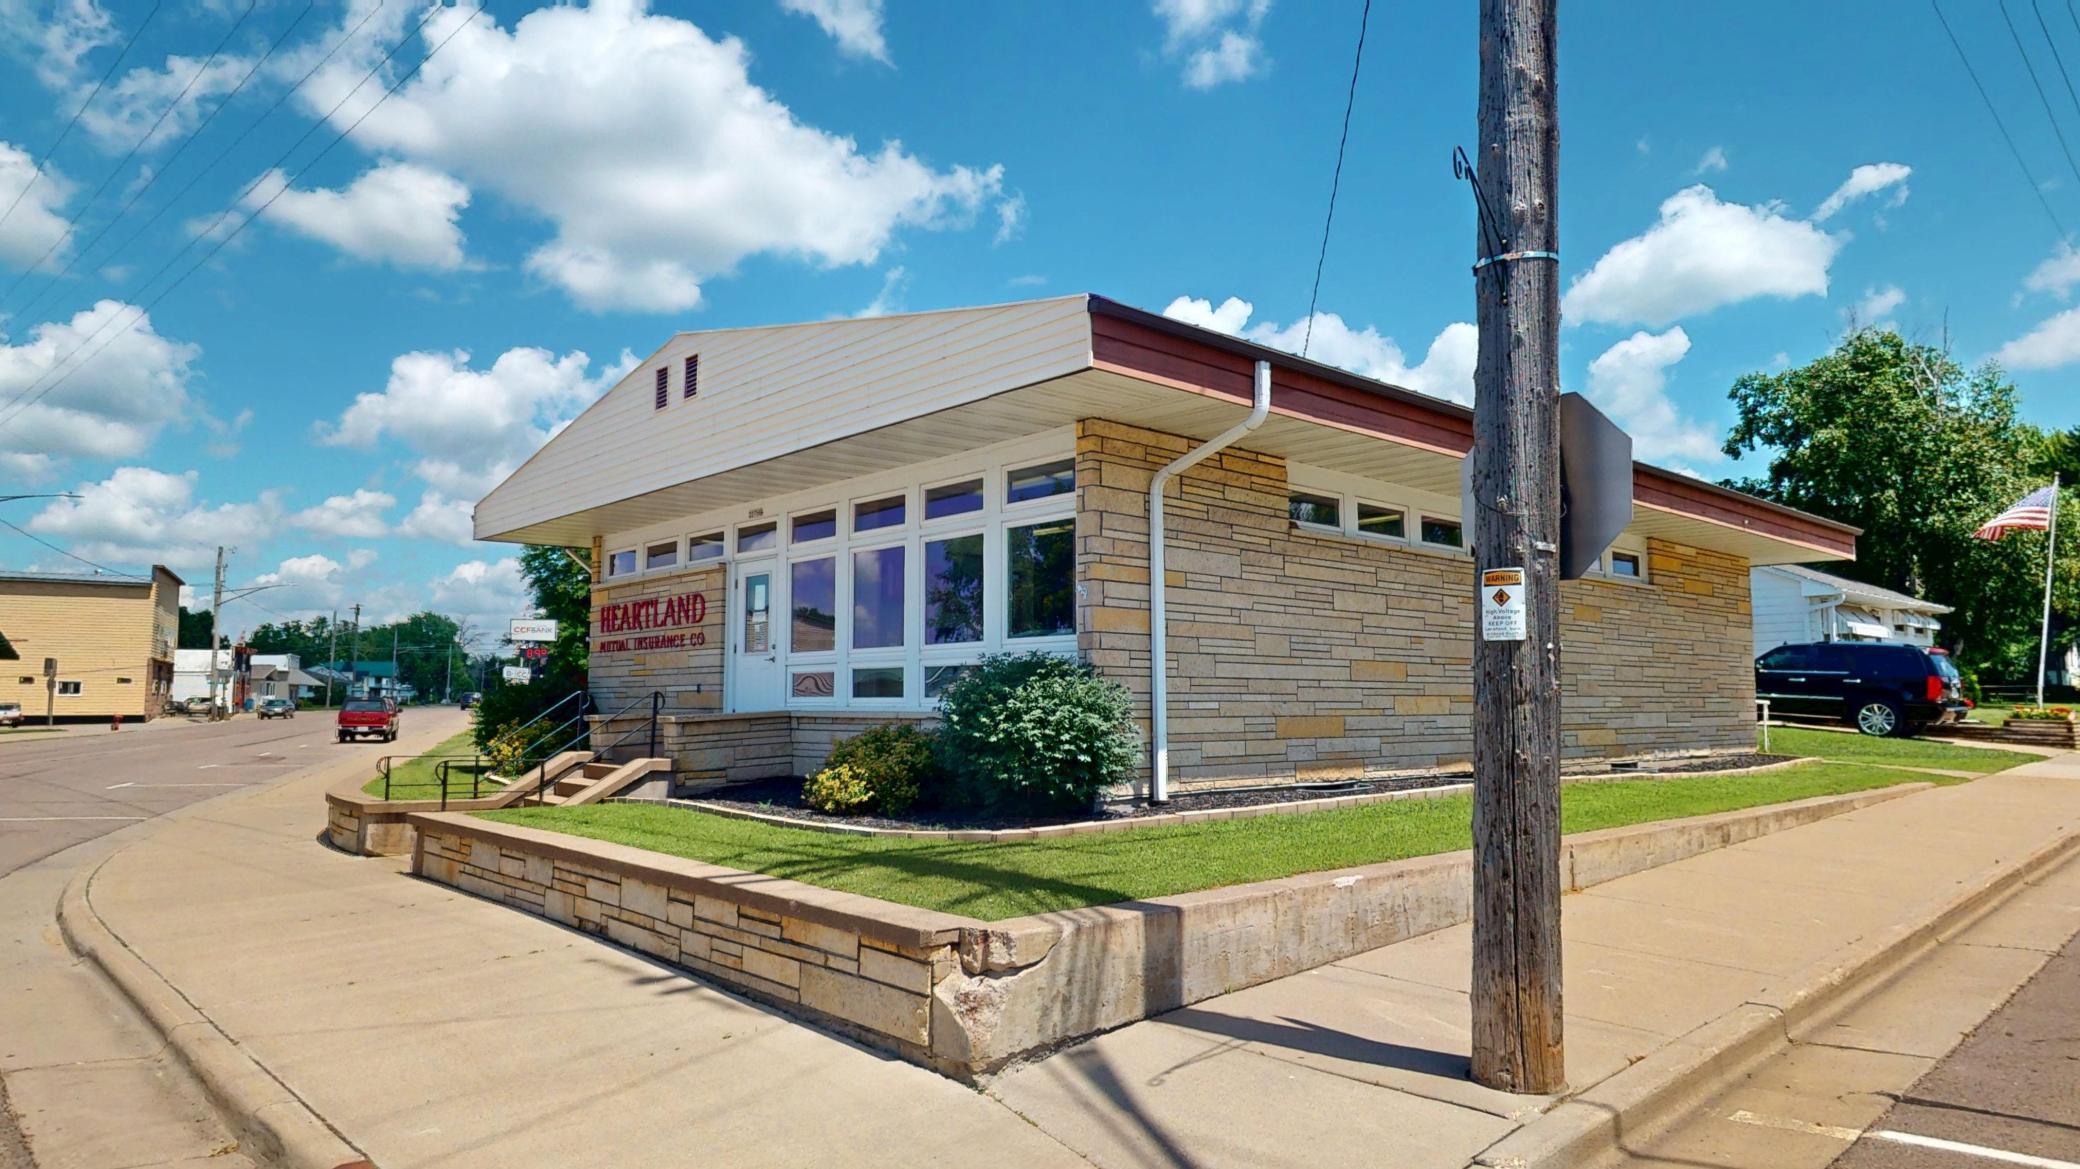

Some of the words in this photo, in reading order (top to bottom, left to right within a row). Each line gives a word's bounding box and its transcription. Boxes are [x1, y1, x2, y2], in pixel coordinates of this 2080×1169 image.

[1485, 574, 1520, 583] WARNING
[600, 592, 706, 634] HEARTLAND
[600, 639, 630, 653] MUTUAL
[634, 634, 686, 651] INSURANCE
[690, 632, 705, 646] CO
